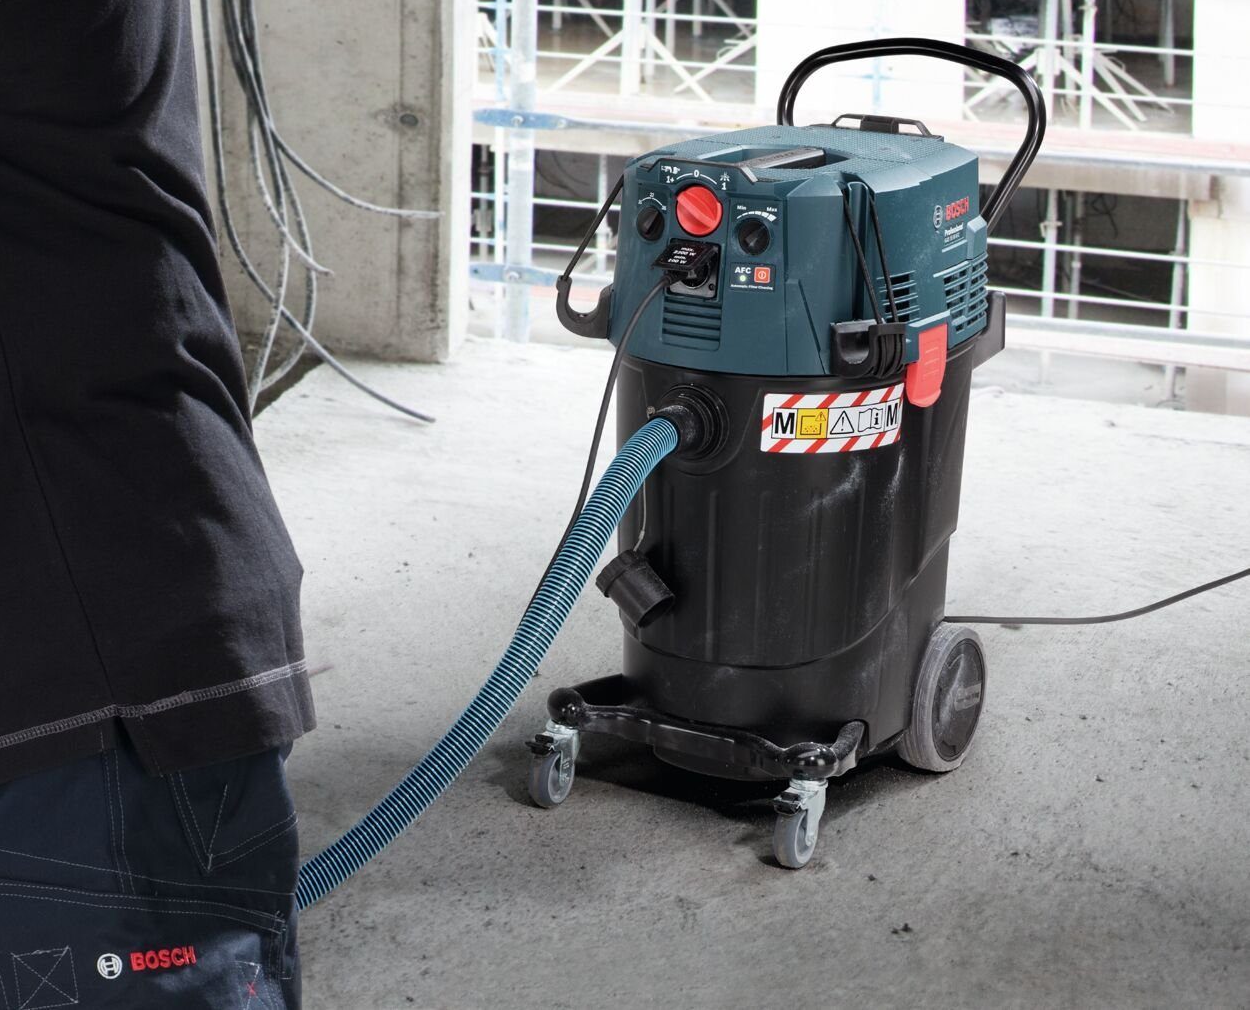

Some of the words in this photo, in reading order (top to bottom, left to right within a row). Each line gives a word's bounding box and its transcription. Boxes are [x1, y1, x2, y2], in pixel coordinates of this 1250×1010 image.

[945, 196, 969, 221] BOSCH
[734, 266, 752, 274] AFC
[774, 412, 795, 435] M
[886, 402, 898, 427] M
[130, 946, 196, 971] BOSCH
